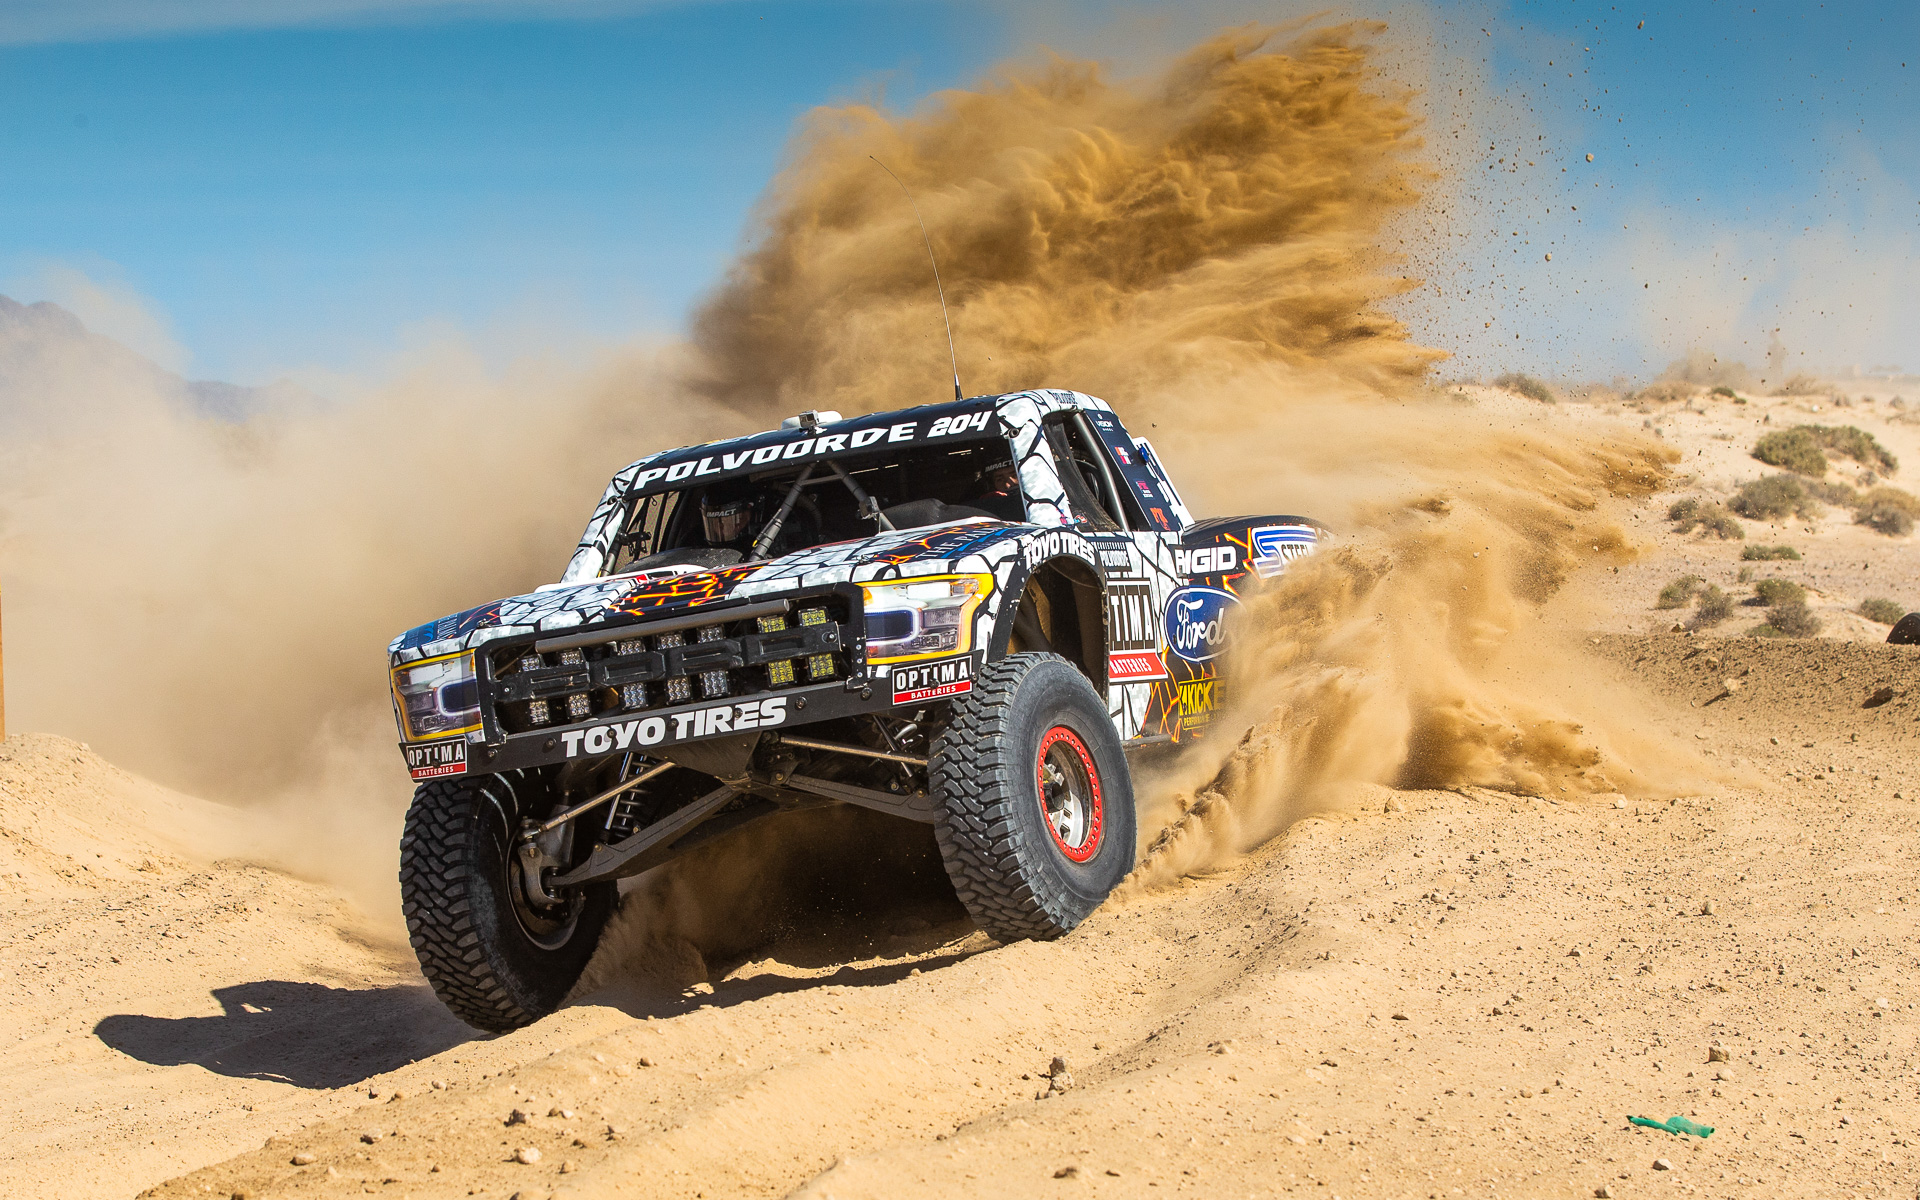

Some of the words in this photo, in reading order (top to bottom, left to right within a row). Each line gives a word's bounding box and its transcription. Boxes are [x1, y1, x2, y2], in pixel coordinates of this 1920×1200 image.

[634, 422, 916, 491] POLVOORDE
[928, 410, 993, 438] 204
[985, 459, 1014, 472] IMPACT
[706, 508, 737, 518] IMPACT
[915, 541, 963, 558] THE
[1023, 531, 1060, 571] TOYO
[1060, 531, 1096, 566] TIRES
[1175, 546, 1237, 574] RIGID
[1110, 594, 1154, 642] TIMA
[1176, 598, 1227, 650] Ford
[896, 661, 969, 690] OPTIMA
[1110, 657, 1153, 674] BATTERIES
[911, 685, 956, 699] BATTERIES
[1187, 681, 1227, 715] KICKE
[561, 715, 666, 758] TOYO
[671, 697, 788, 741] TIRES
[409, 743, 464, 766] OPTIMA
[418, 766, 454, 777] BATTERIES
